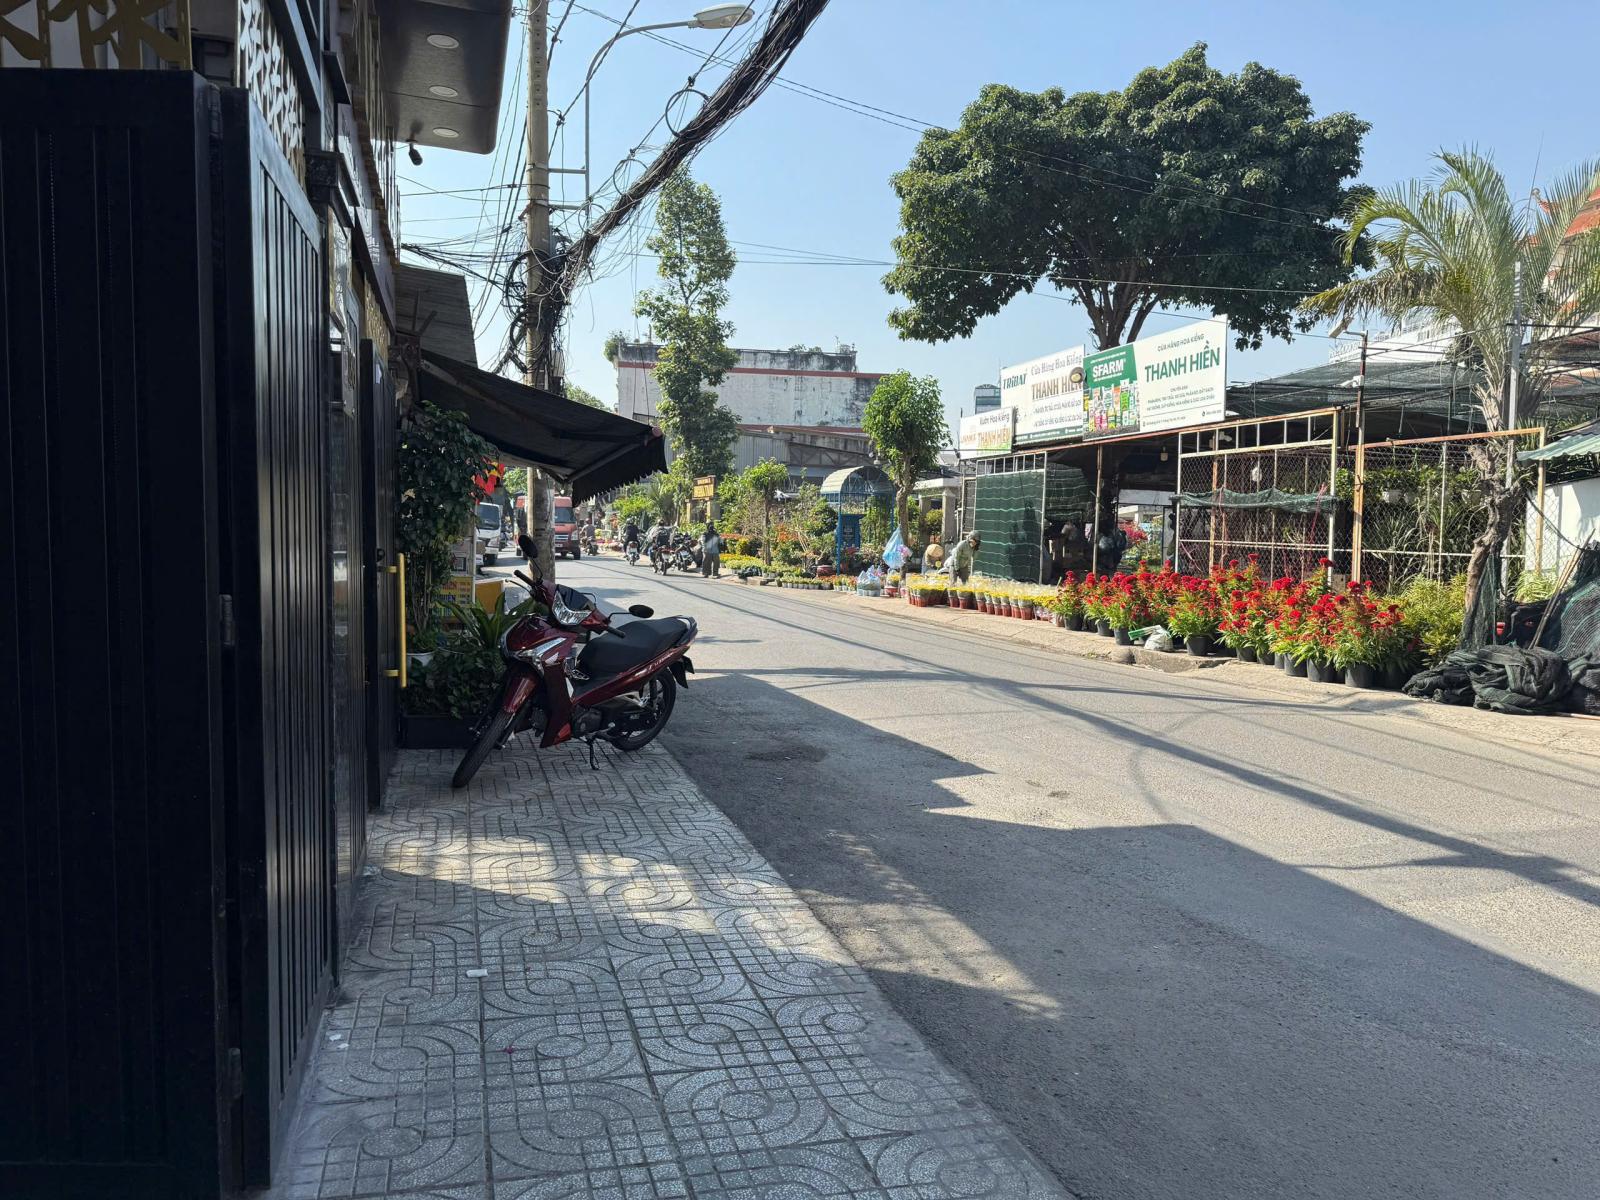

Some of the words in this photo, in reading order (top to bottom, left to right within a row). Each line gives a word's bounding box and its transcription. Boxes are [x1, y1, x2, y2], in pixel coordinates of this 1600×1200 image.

[1092, 359, 1125, 378] SFARM
[1145, 357, 1187, 383] THANH
[1189, 340, 1221, 372] HIỀN
[1031, 379, 1060, 400] THANH
